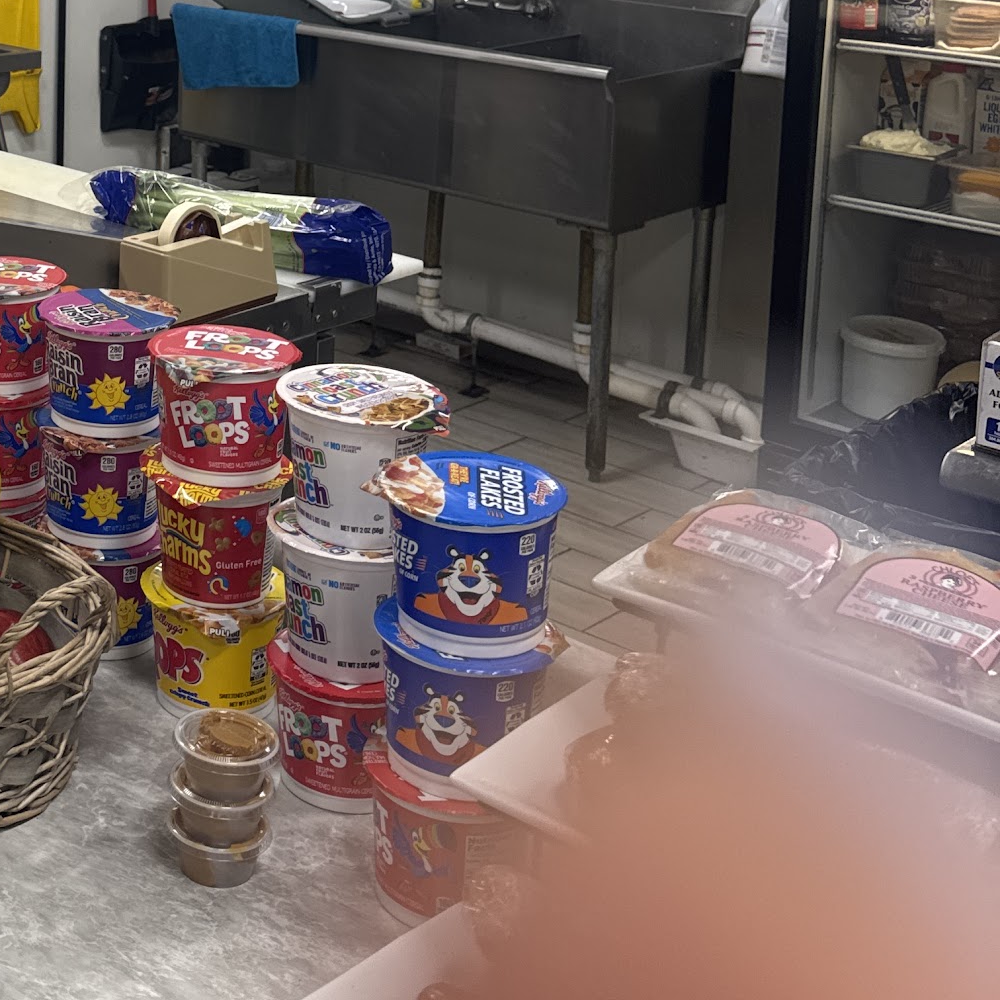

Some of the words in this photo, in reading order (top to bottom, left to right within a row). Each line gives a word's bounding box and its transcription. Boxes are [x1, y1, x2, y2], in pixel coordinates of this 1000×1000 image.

[184, 330, 290, 350] FROOT
[184, 340, 280, 360] LOOPS
[52, 378, 78, 400] runch
[170, 396, 246, 426] FROOT
[178, 421, 250, 448] LOOPS
[102, 457, 115, 465] 280
[479, 467, 503, 511] FLAKES
[502, 466, 526, 516] FROSTED
[392, 534, 419, 556] STED
[522, 535, 535, 545] 220
[124, 567, 137, 575] 280
[216, 560, 240, 570] Gluten
[242, 558, 262, 568] Free
[405, 572, 419, 582] CORN
[497, 682, 514, 693] 220
[278, 704, 343, 742] FROOT
[285, 734, 348, 768] LOOPS
